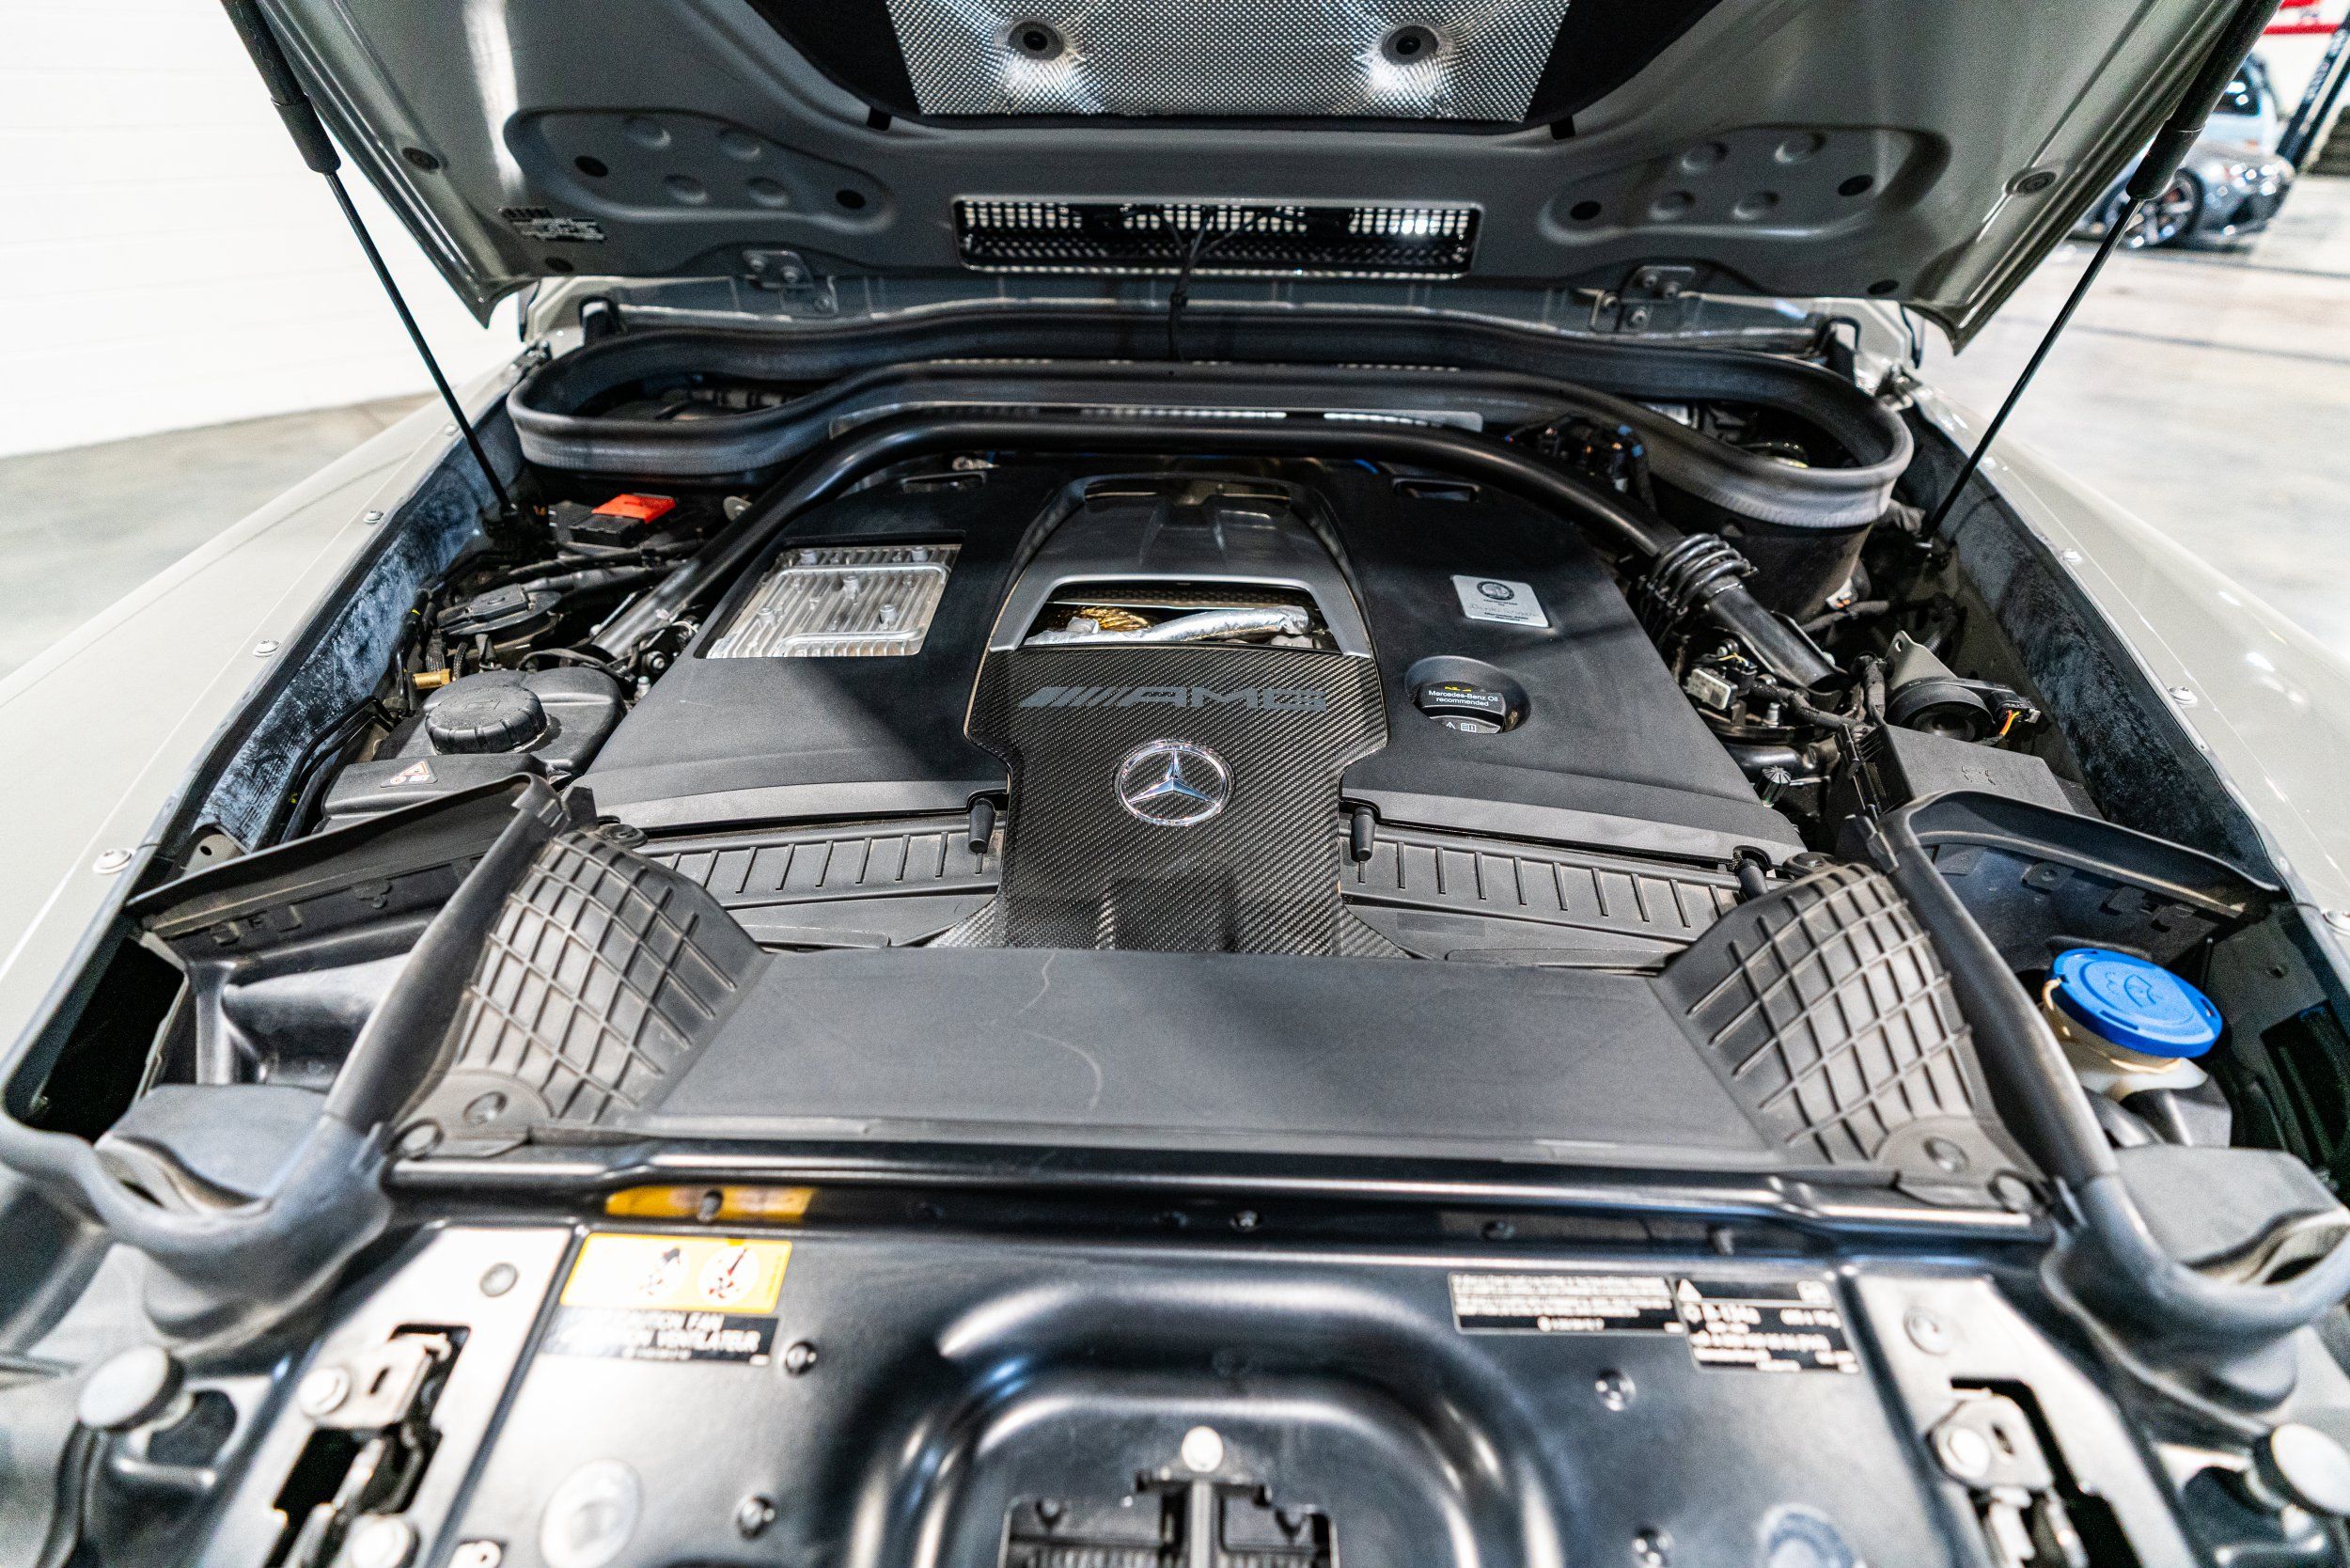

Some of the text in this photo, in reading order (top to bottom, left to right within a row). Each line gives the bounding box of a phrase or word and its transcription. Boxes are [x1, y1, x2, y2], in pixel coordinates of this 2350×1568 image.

[1119, 686, 1326, 712] AMG
[1429, 690, 1486, 700] Mercedes-Benz
[1436, 698, 1489, 706] recommended
